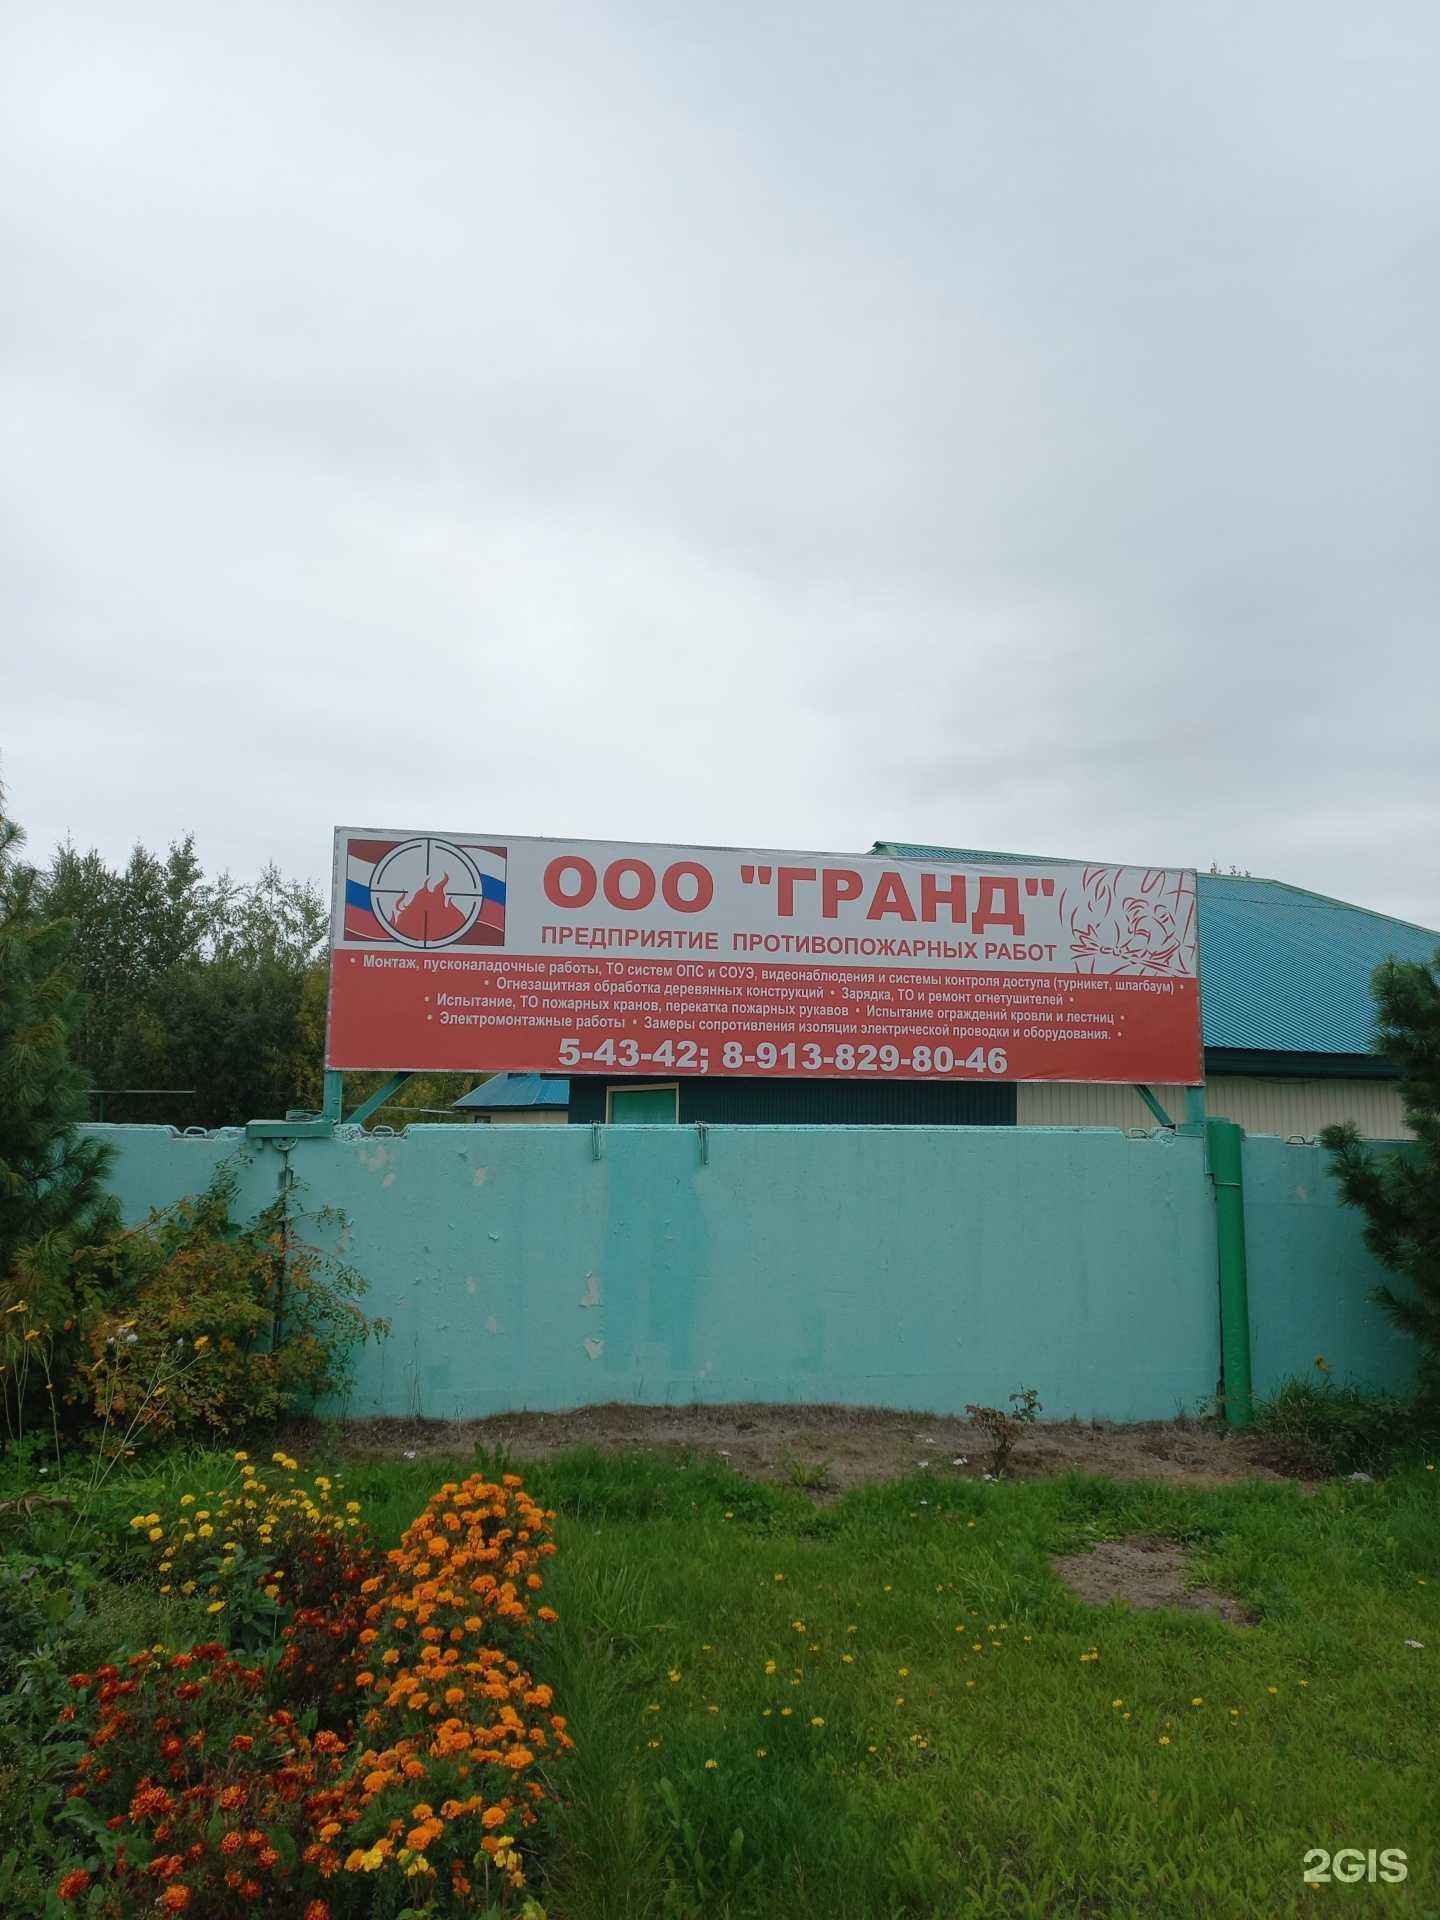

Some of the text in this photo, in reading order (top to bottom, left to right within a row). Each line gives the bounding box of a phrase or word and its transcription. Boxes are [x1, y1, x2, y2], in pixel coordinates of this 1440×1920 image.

[543, 855, 1055, 936] ООО "ГРАНД"
[541, 925, 1057, 962] ПРЕДПРИЯТИЕ ПРОТИВОПОЖАРНЫХ РАБОТ
[363, 954, 1174, 995] Монтаж, пусконаладочные работы, ТО систем ОПС и СОУЭ, видеонаблюдения и системы контроля доступа (турникет, шлагбаум)
[496, 977, 1063, 1006] Огнезащитная обработка деревянных конструкций Зарядка, ТО и ремонт огнетушителей
[437, 992, 1114, 1025] Испытание, ТО пожарных кранов, перекатка пожарных рукавов Испытание ограждений кровли и лестниц
[440, 1011, 1111, 1041] Электромонтажные работы Замеры сопротивления изоляции электрической проводки и оборудования.
[558, 1038, 1008, 1074] 5-43-42; 8-913-829-80-46
